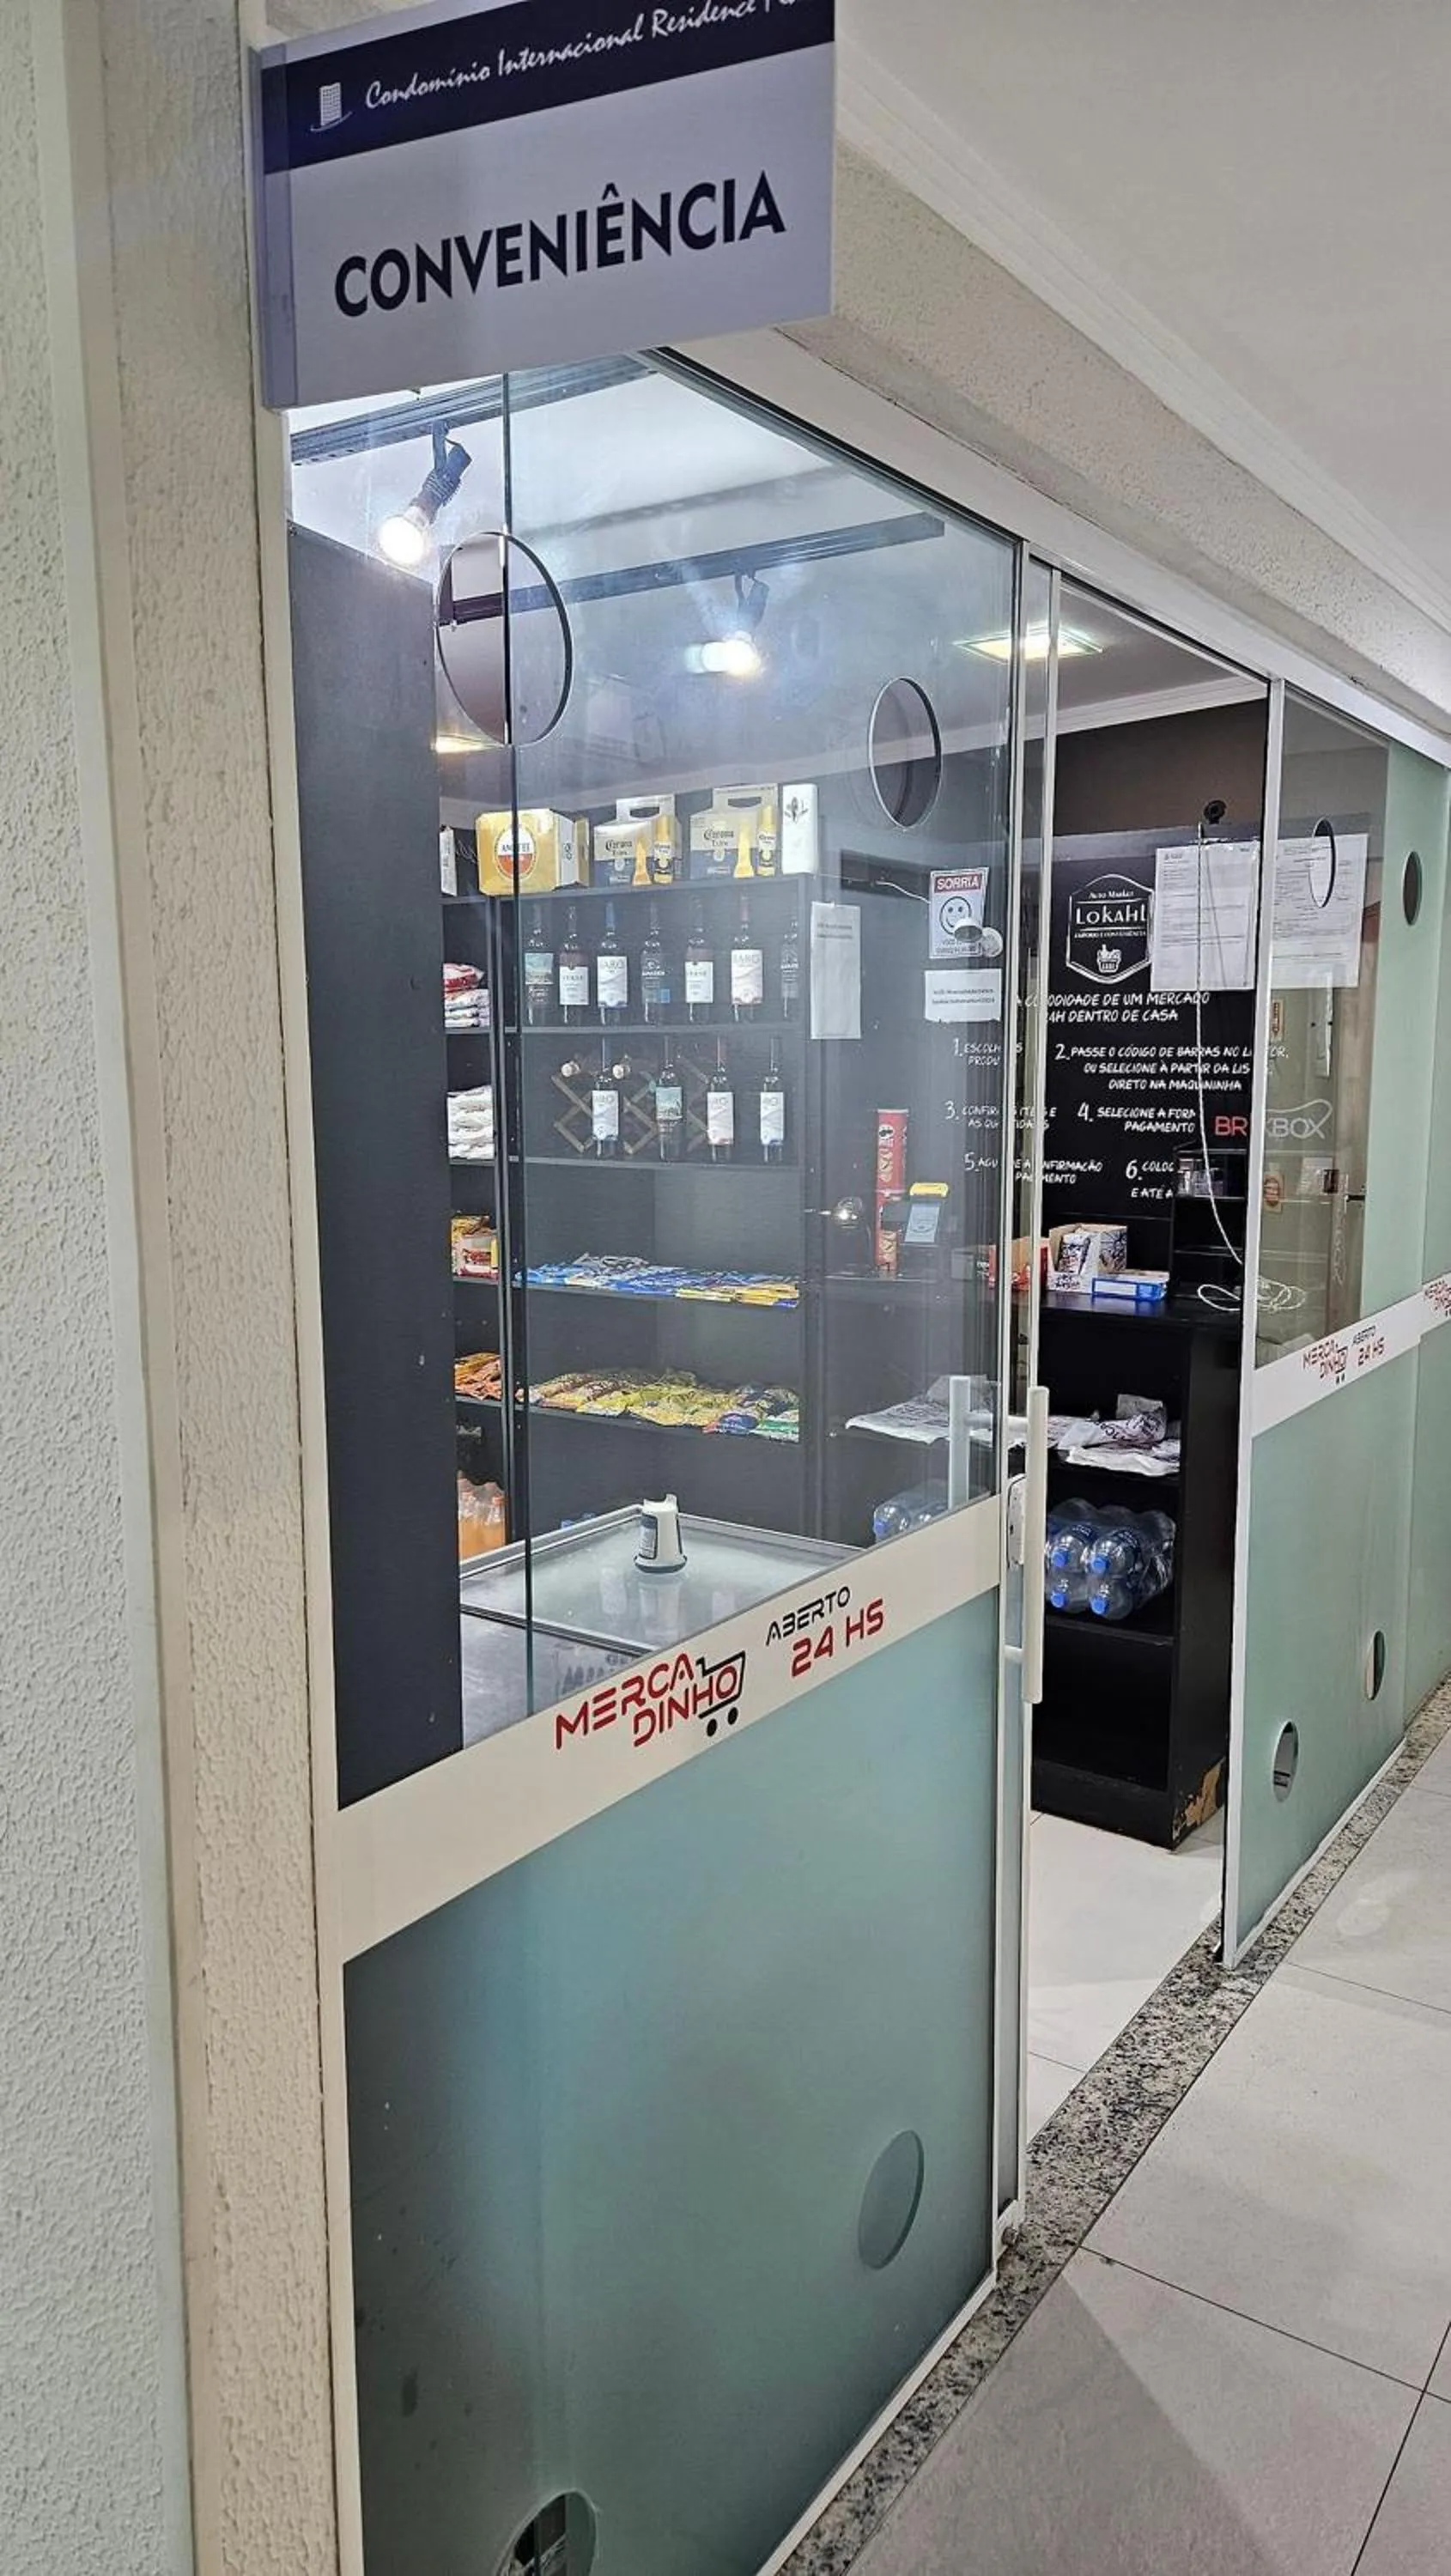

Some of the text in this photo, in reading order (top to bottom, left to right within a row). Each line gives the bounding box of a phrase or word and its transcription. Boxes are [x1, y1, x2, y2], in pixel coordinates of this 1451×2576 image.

[365, 0, 756, 108] Condomínio Internacional Residence
[335, 170, 786, 317] CONVENIÊNCIA
[937, 876, 979, 890] SORRIA
[1102, 993, 1120, 1006] DE
[1123, 993, 1143, 1005] UM
[1146, 992, 1210, 1006] MERCADO
[1068, 1009, 1119, 1023] DENTRO
[1121, 1008, 1139, 1023] DE
[1142, 1009, 1179, 1023] CASA
[1071, 1046, 1107, 1057] PASSE
[1117, 1043, 1157, 1057] CÓDIGO
[1158, 1046, 1175, 1058] DE
[1223, 1045, 1240, 1057] NO
[1099, 1062, 1157, 1074] SELECIONE
[1213, 1063, 1229, 1074] DA
[1149, 1078, 1166, 1090] NA
[1096, 1107, 1157, 1119] SELECIONE
[1124, 1121, 1196, 1133] PAGAMENTO
[766, 1586, 851, 1647] ABERTO
[791, 1598, 884, 1677] 24 HS
[556, 1653, 695, 1749] MERCA
[634, 1666, 738, 1747] DINHO
